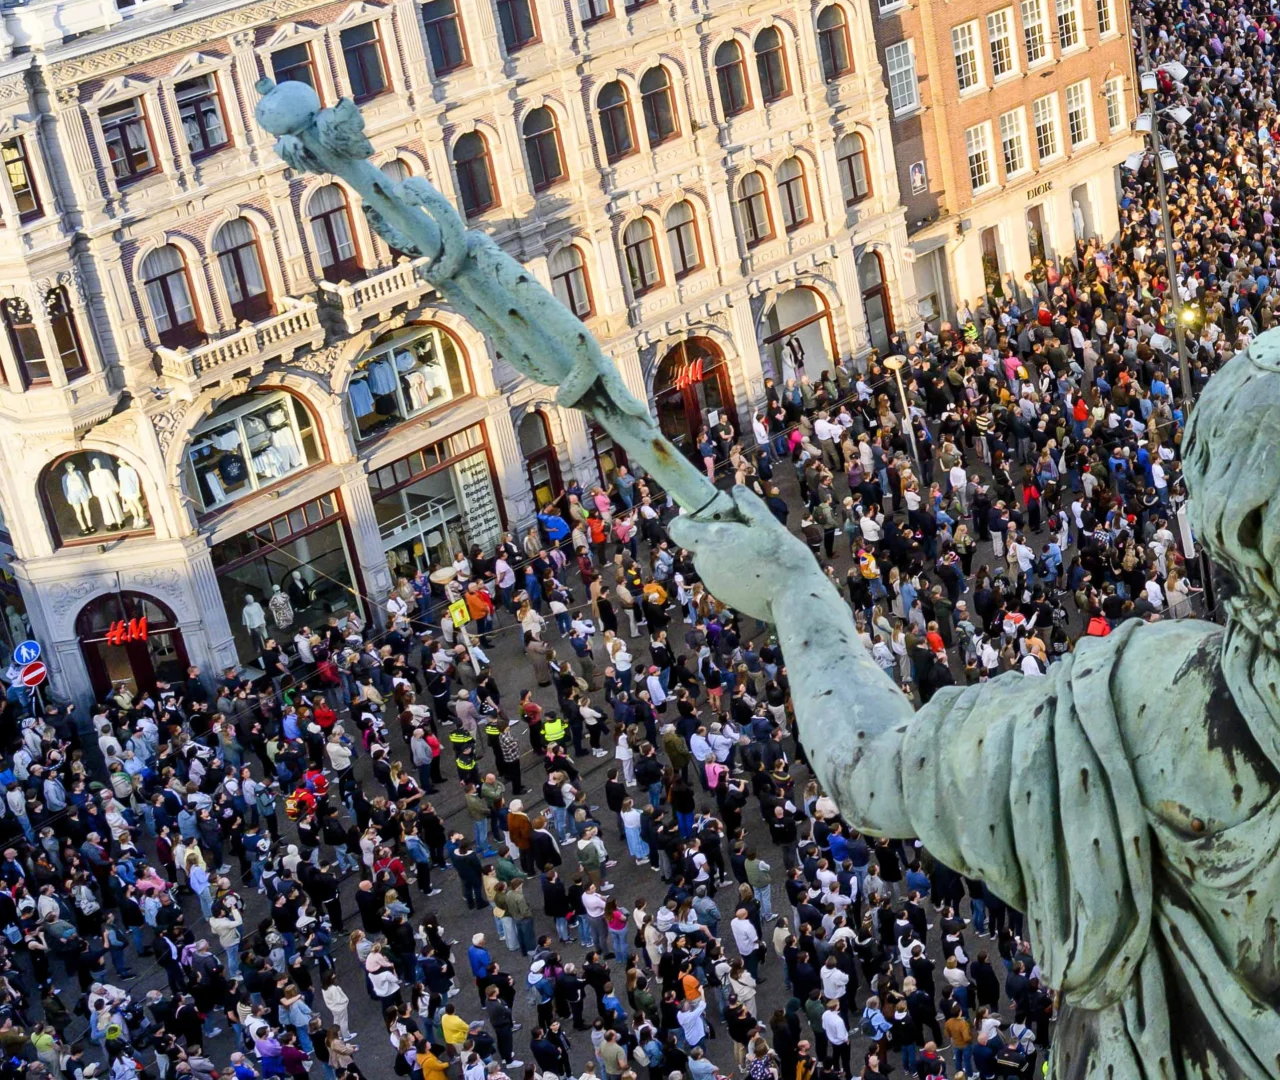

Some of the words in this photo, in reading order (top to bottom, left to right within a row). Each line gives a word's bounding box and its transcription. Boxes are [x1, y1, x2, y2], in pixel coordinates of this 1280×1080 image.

[1026, 180, 1053, 200] DIOR
[460, 460, 484, 474] Women
[471, 468, 486, 477] Men
[463, 476, 488, 491] Divided
[465, 484, 489, 498] Beauty
[472, 491, 492, 504] Sport
[469, 500, 494, 514] Collect
[469, 508, 495, 522] Returns
[483, 516, 497, 525] Box
[482, 523, 499, 534] more
[105, 616, 147, 646] H&M
